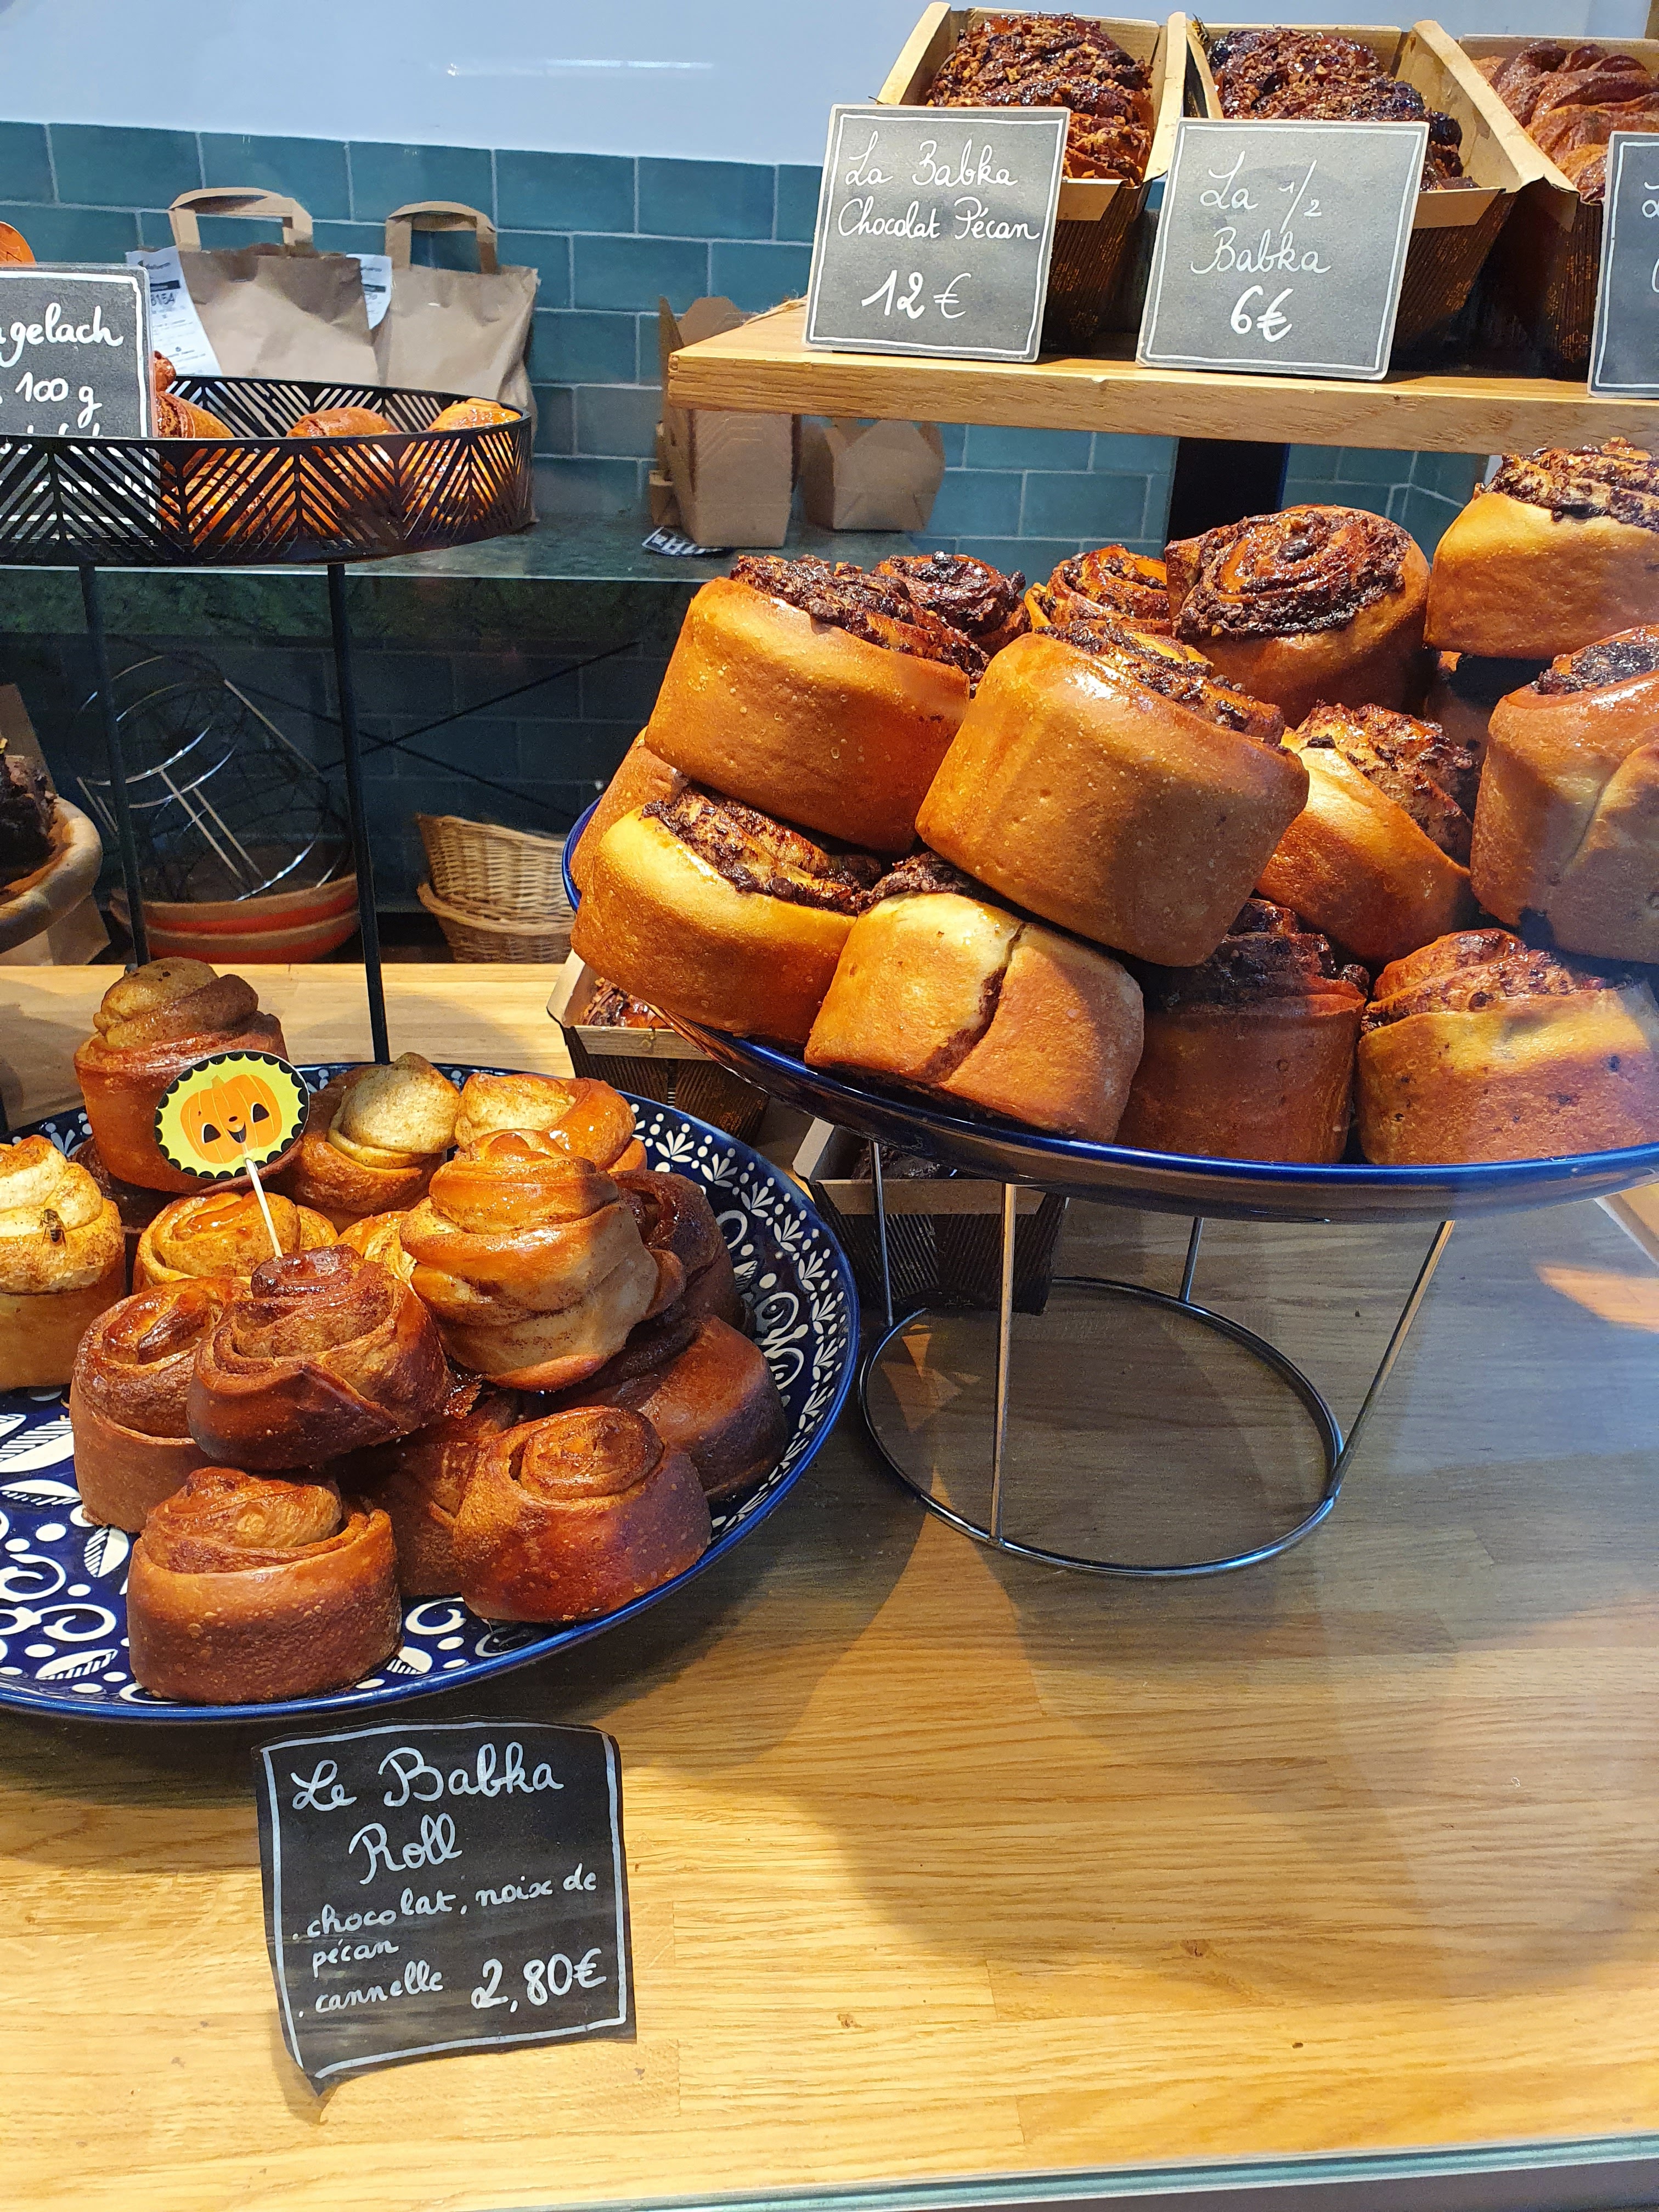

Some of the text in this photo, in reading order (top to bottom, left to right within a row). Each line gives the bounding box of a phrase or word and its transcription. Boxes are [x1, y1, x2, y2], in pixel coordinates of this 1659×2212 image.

[845, 131, 1018, 187] La Babka
[1200, 150, 1259, 210] La
[838, 196, 1040, 240] Chocolat Pécan
[1190, 226, 1331, 274] Babka
[0, 303, 123, 368] gelach
[1231, 285, 1294, 342] 6€
[15, 371, 103, 428] 100 g
[291, 1742, 564, 1810] Le Babka
[349, 1812, 462, 1884] Roll
[475, 1876, 552, 1906] noix
[563, 1863, 597, 1892] de
[312, 1940, 399, 1978] pécan
[471, 1948, 607, 2013] 2,80€
